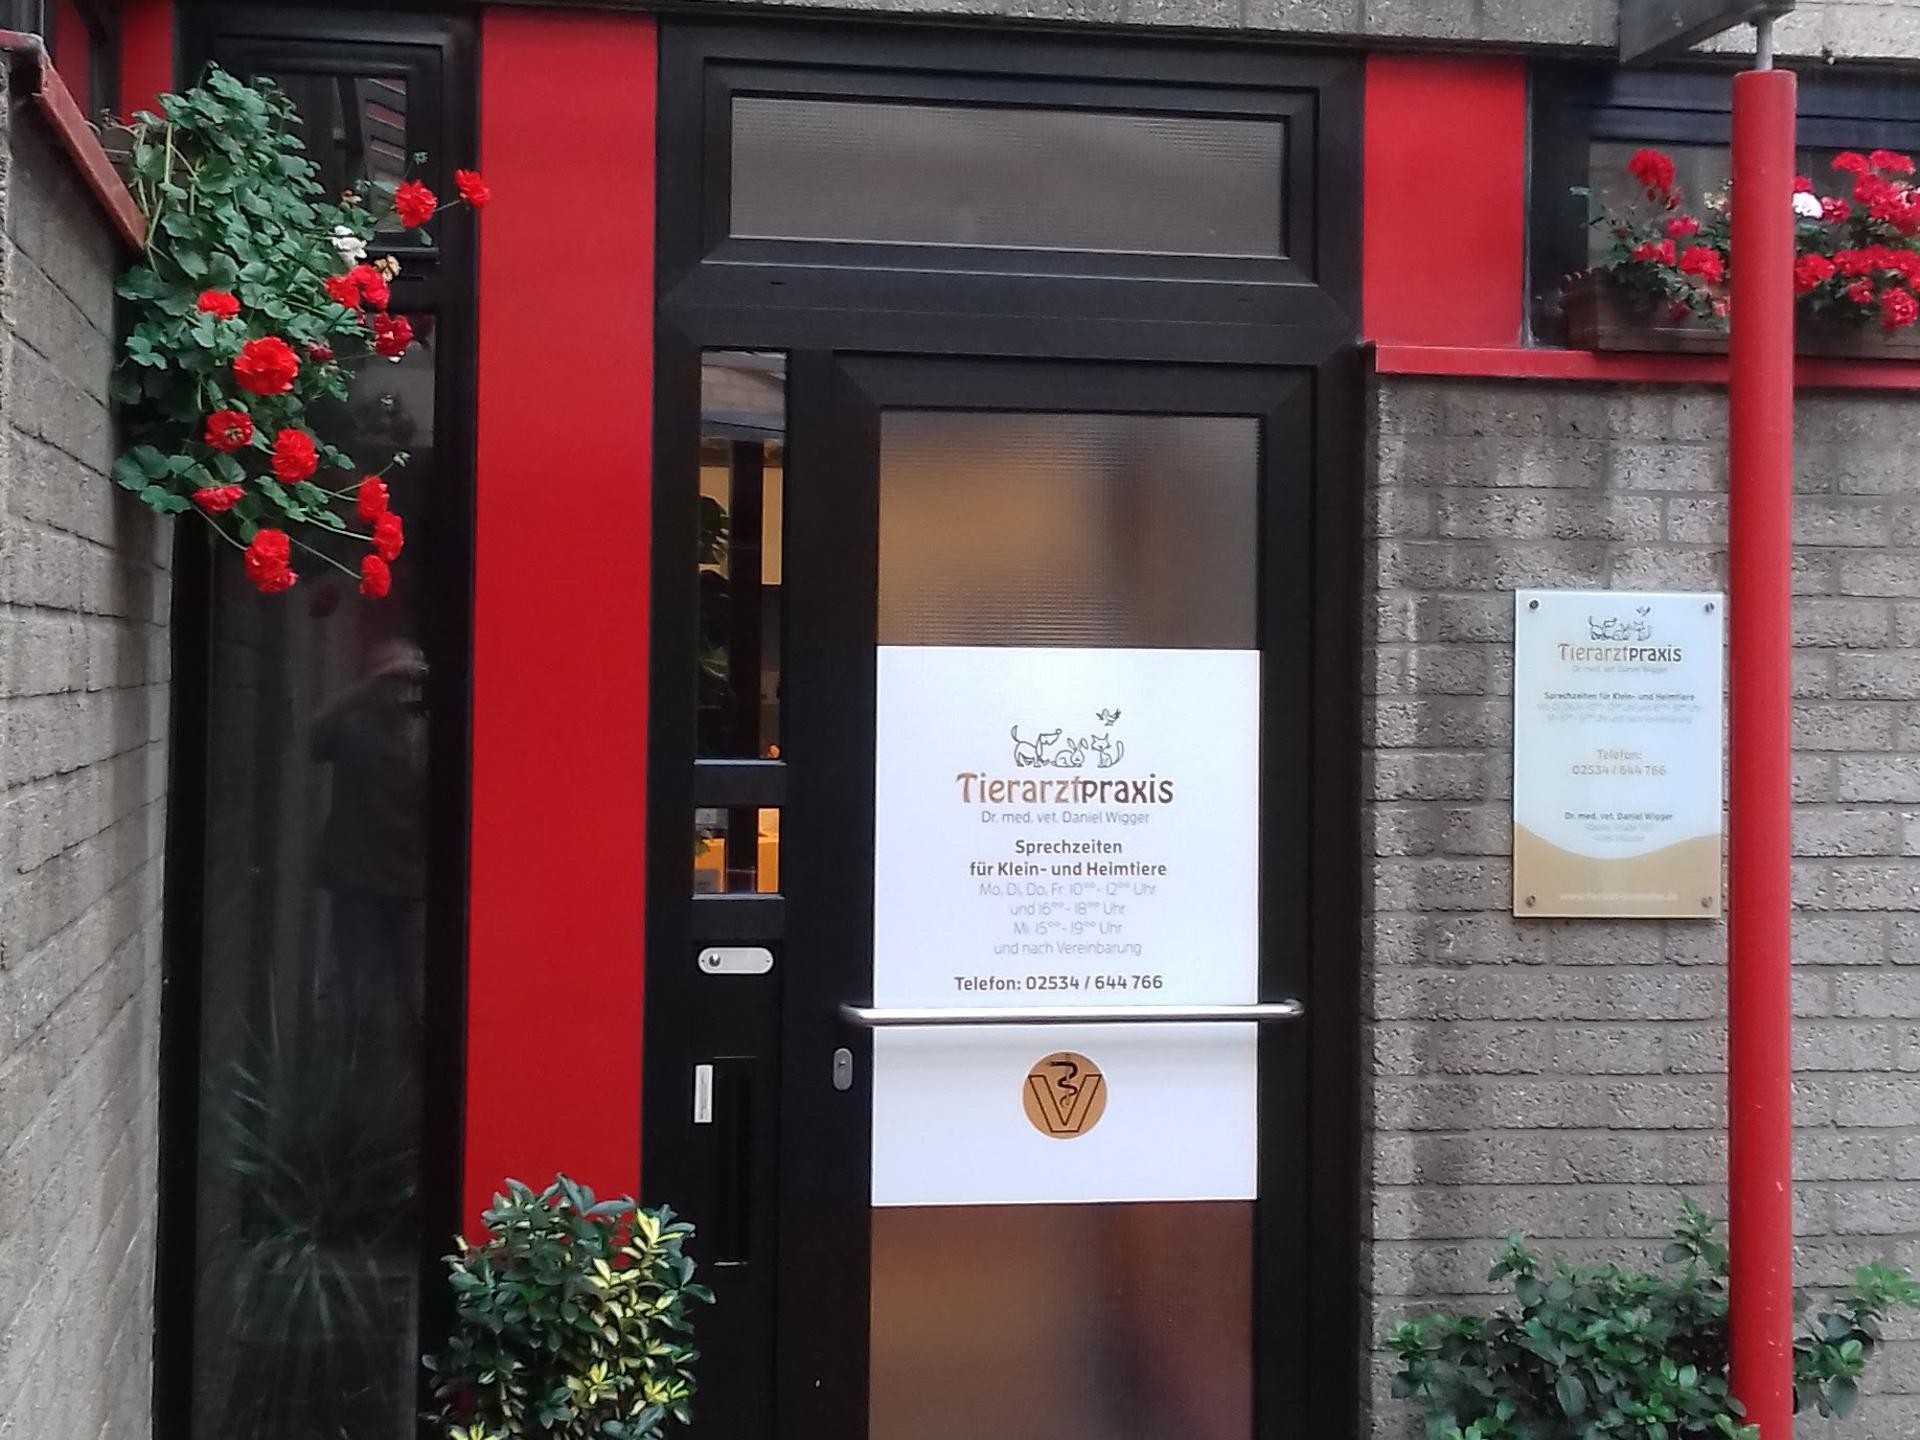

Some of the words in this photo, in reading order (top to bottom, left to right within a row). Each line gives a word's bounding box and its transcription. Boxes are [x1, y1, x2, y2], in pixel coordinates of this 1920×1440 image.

[1558, 643, 1682, 662] Tierarztpraxis
[1597, 749, 1642, 760] Telefon:
[1572, 765, 1609, 776] 02534
[1619, 765, 1642, 776] 644
[1645, 765, 1667, 776] 766
[956, 772, 1174, 804] Tierarztpraxis
[981, 811, 998, 824] Dr.
[1002, 811, 1033, 824] med.
[1037, 811, 1058, 824] vet.
[1062, 811, 1102, 824] Daniel
[1105, 811, 1150, 826] Wigger
[1015, 839, 1122, 856] Sprechzeiten
[970, 861, 994, 876] für
[998, 861, 1047, 876] Klein-
[1051, 861, 1082, 876] und
[1086, 861, 1168, 876] Heimtiere
[1134, 882, 1157, 896] Uhr
[1010, 901, 1035, 916] und
[1103, 901, 1126, 916] Uhr
[1099, 921, 1123, 935] Uhr
[994, 942, 1018, 955] und
[1022, 942, 1053, 955] nach
[1056, 941, 1142, 957] Vereinbarung
[955, 976, 1022, 991] Telefon:
[1026, 976, 1080, 991] 02534
[1095, 976, 1129, 991] 644
[1132, 976, 1164, 991] 766
